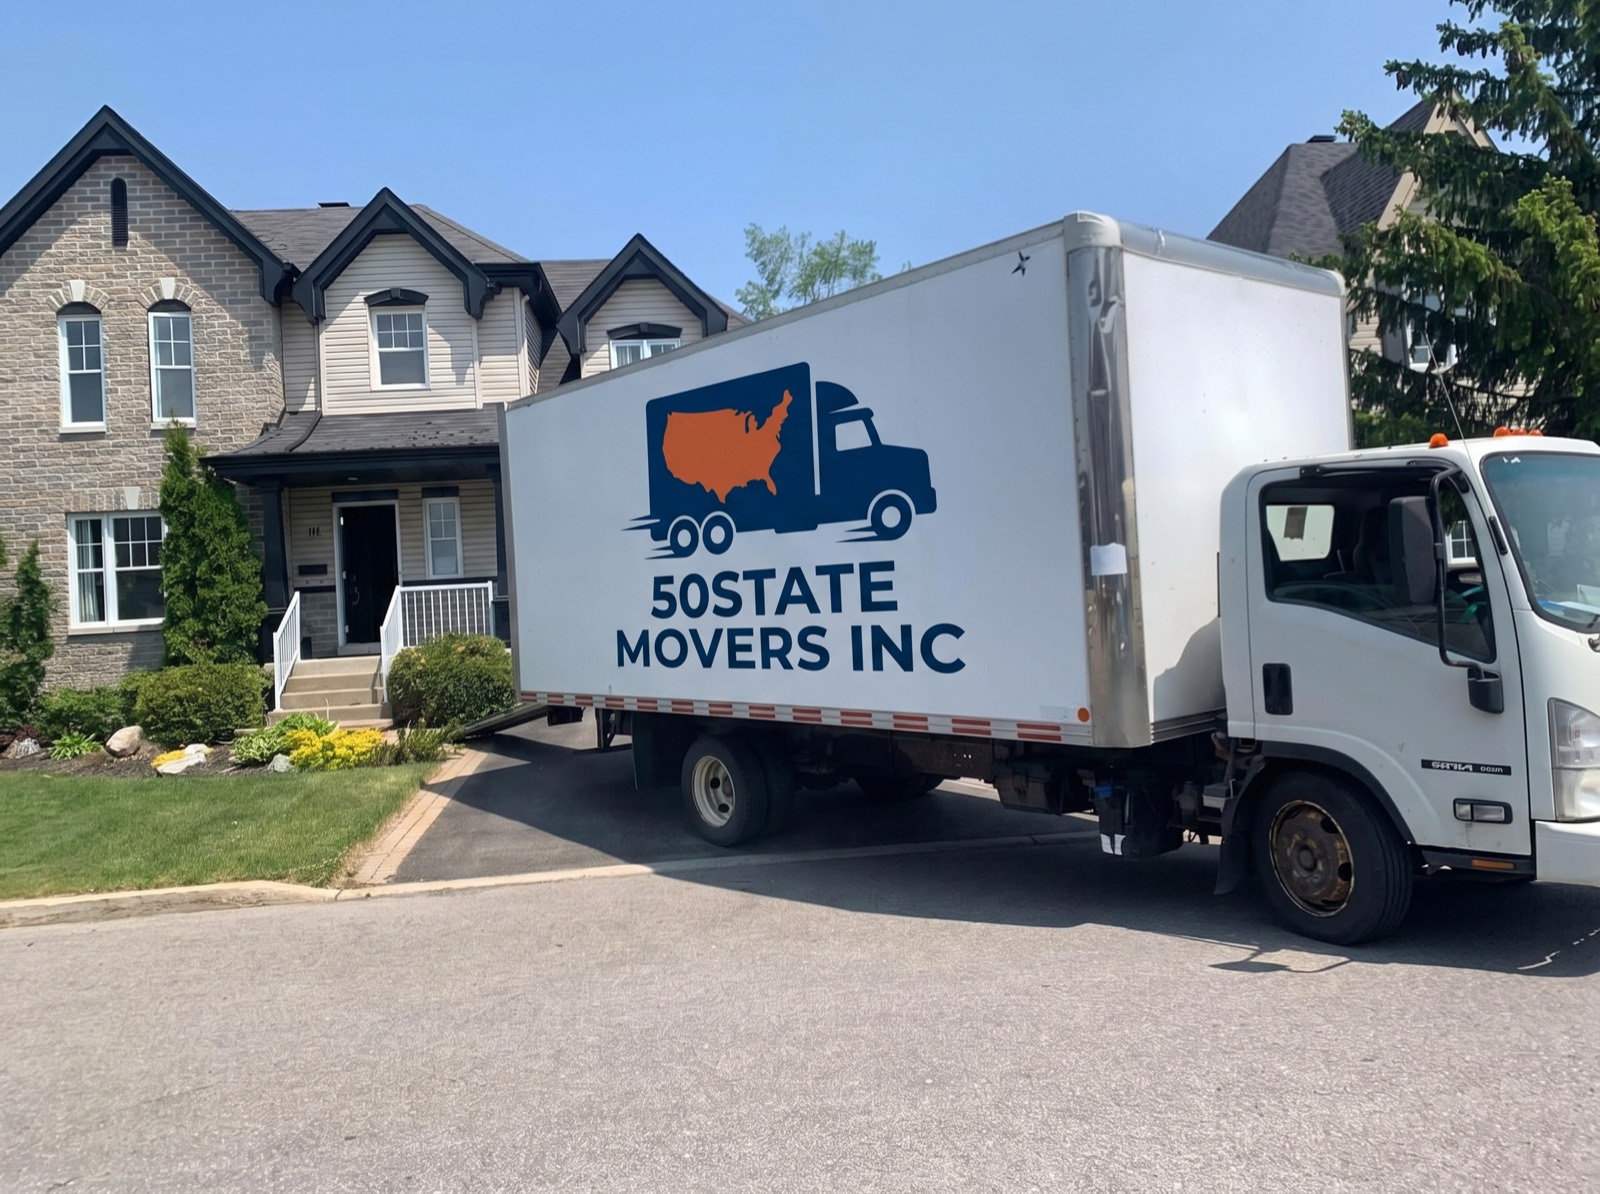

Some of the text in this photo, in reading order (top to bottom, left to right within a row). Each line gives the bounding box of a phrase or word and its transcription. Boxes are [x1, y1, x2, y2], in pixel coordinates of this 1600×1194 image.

[650, 560, 899, 619] 50STATE
[616, 622, 966, 674] MOVERS INC
